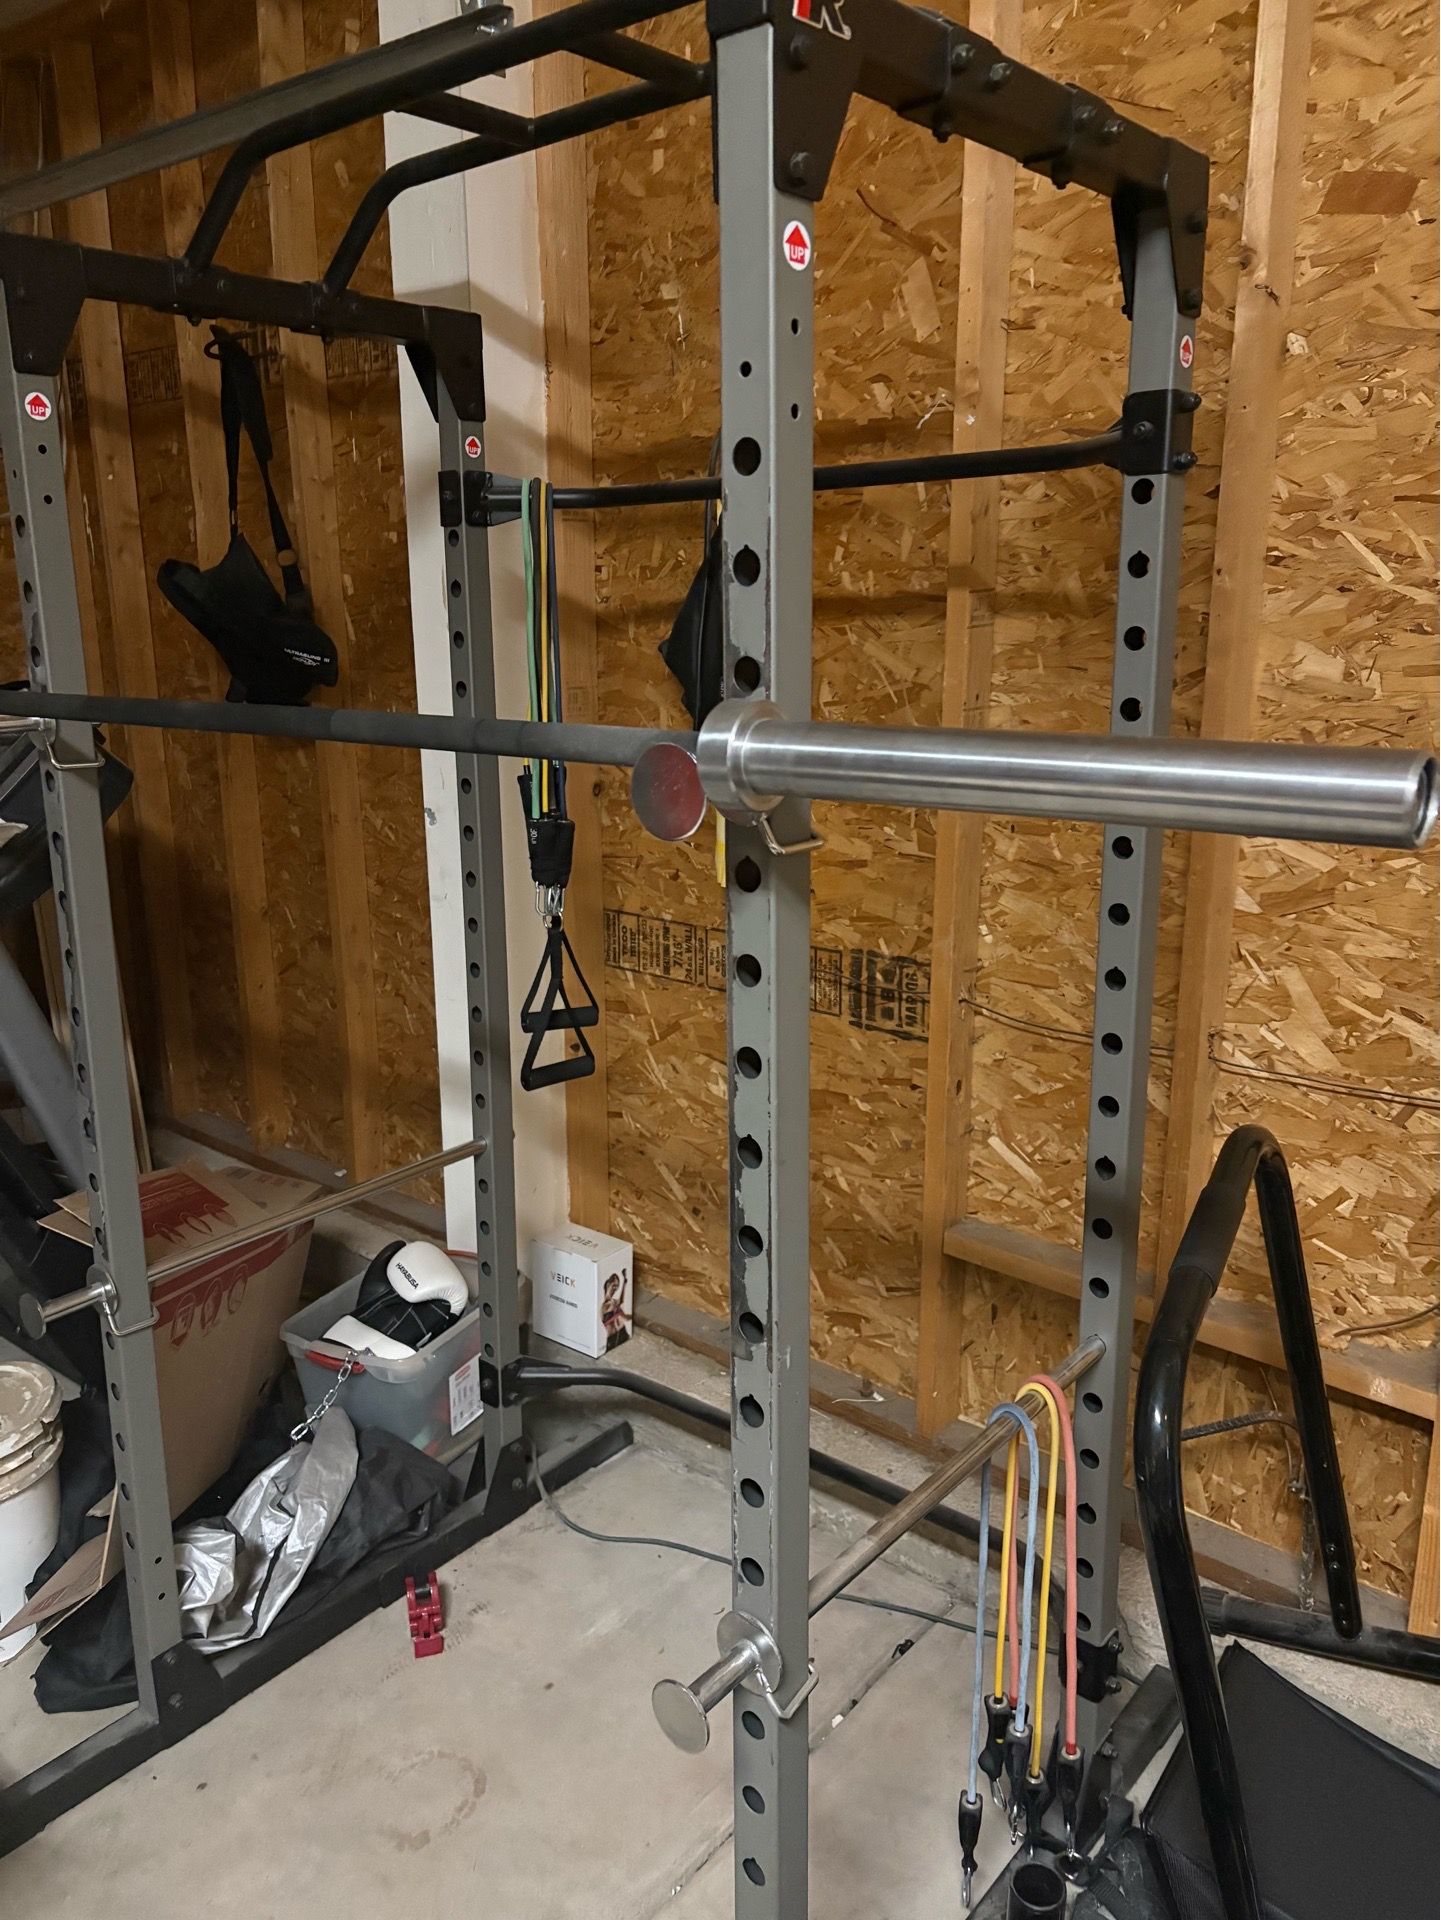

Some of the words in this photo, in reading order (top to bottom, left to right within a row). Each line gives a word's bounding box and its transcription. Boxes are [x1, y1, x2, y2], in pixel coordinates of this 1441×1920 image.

[790, 244, 805, 261] UP
[31, 405, 45, 415] UP
[684, 928, 693, 954] WALL
[905, 995, 918, 1027] MAR
[395, 1262, 419, 1290] HAYABUSA
[550, 1271, 576, 1288] VEICK
